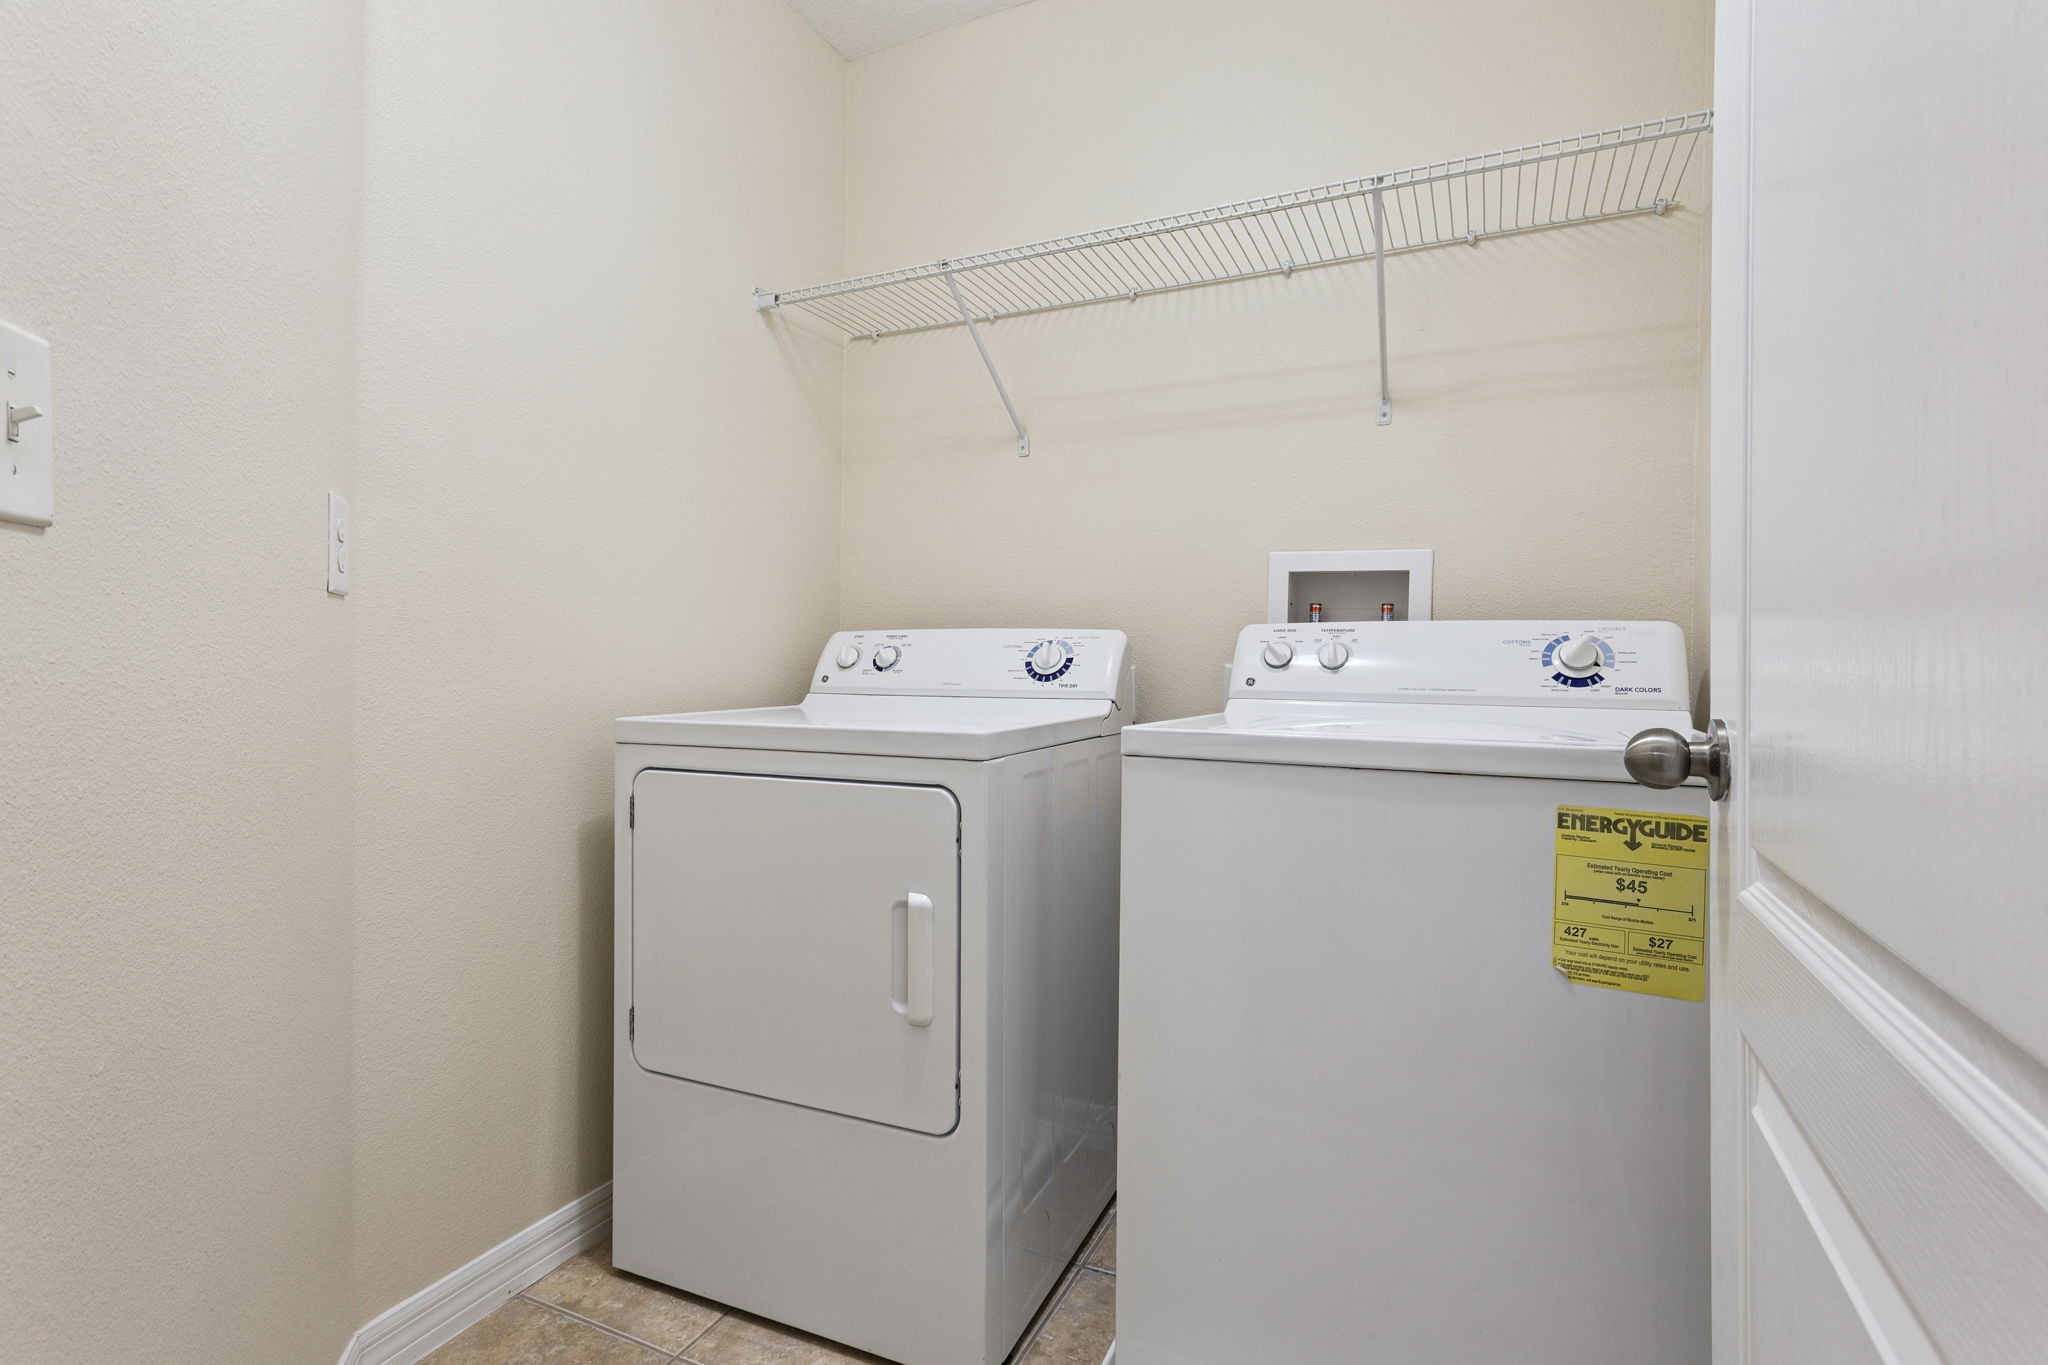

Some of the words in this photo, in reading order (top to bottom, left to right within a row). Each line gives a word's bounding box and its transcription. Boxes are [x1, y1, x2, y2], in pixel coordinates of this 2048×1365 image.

[1614, 865, 1631, 873] Yearly
[1632, 867, 1658, 876] Operating
[1616, 877, 1648, 894] $45
[1563, 926, 1588, 938] 427
[1648, 936, 1674, 950] $27
[1598, 954, 1617, 962] depend
[1639, 960, 1652, 968] utility
